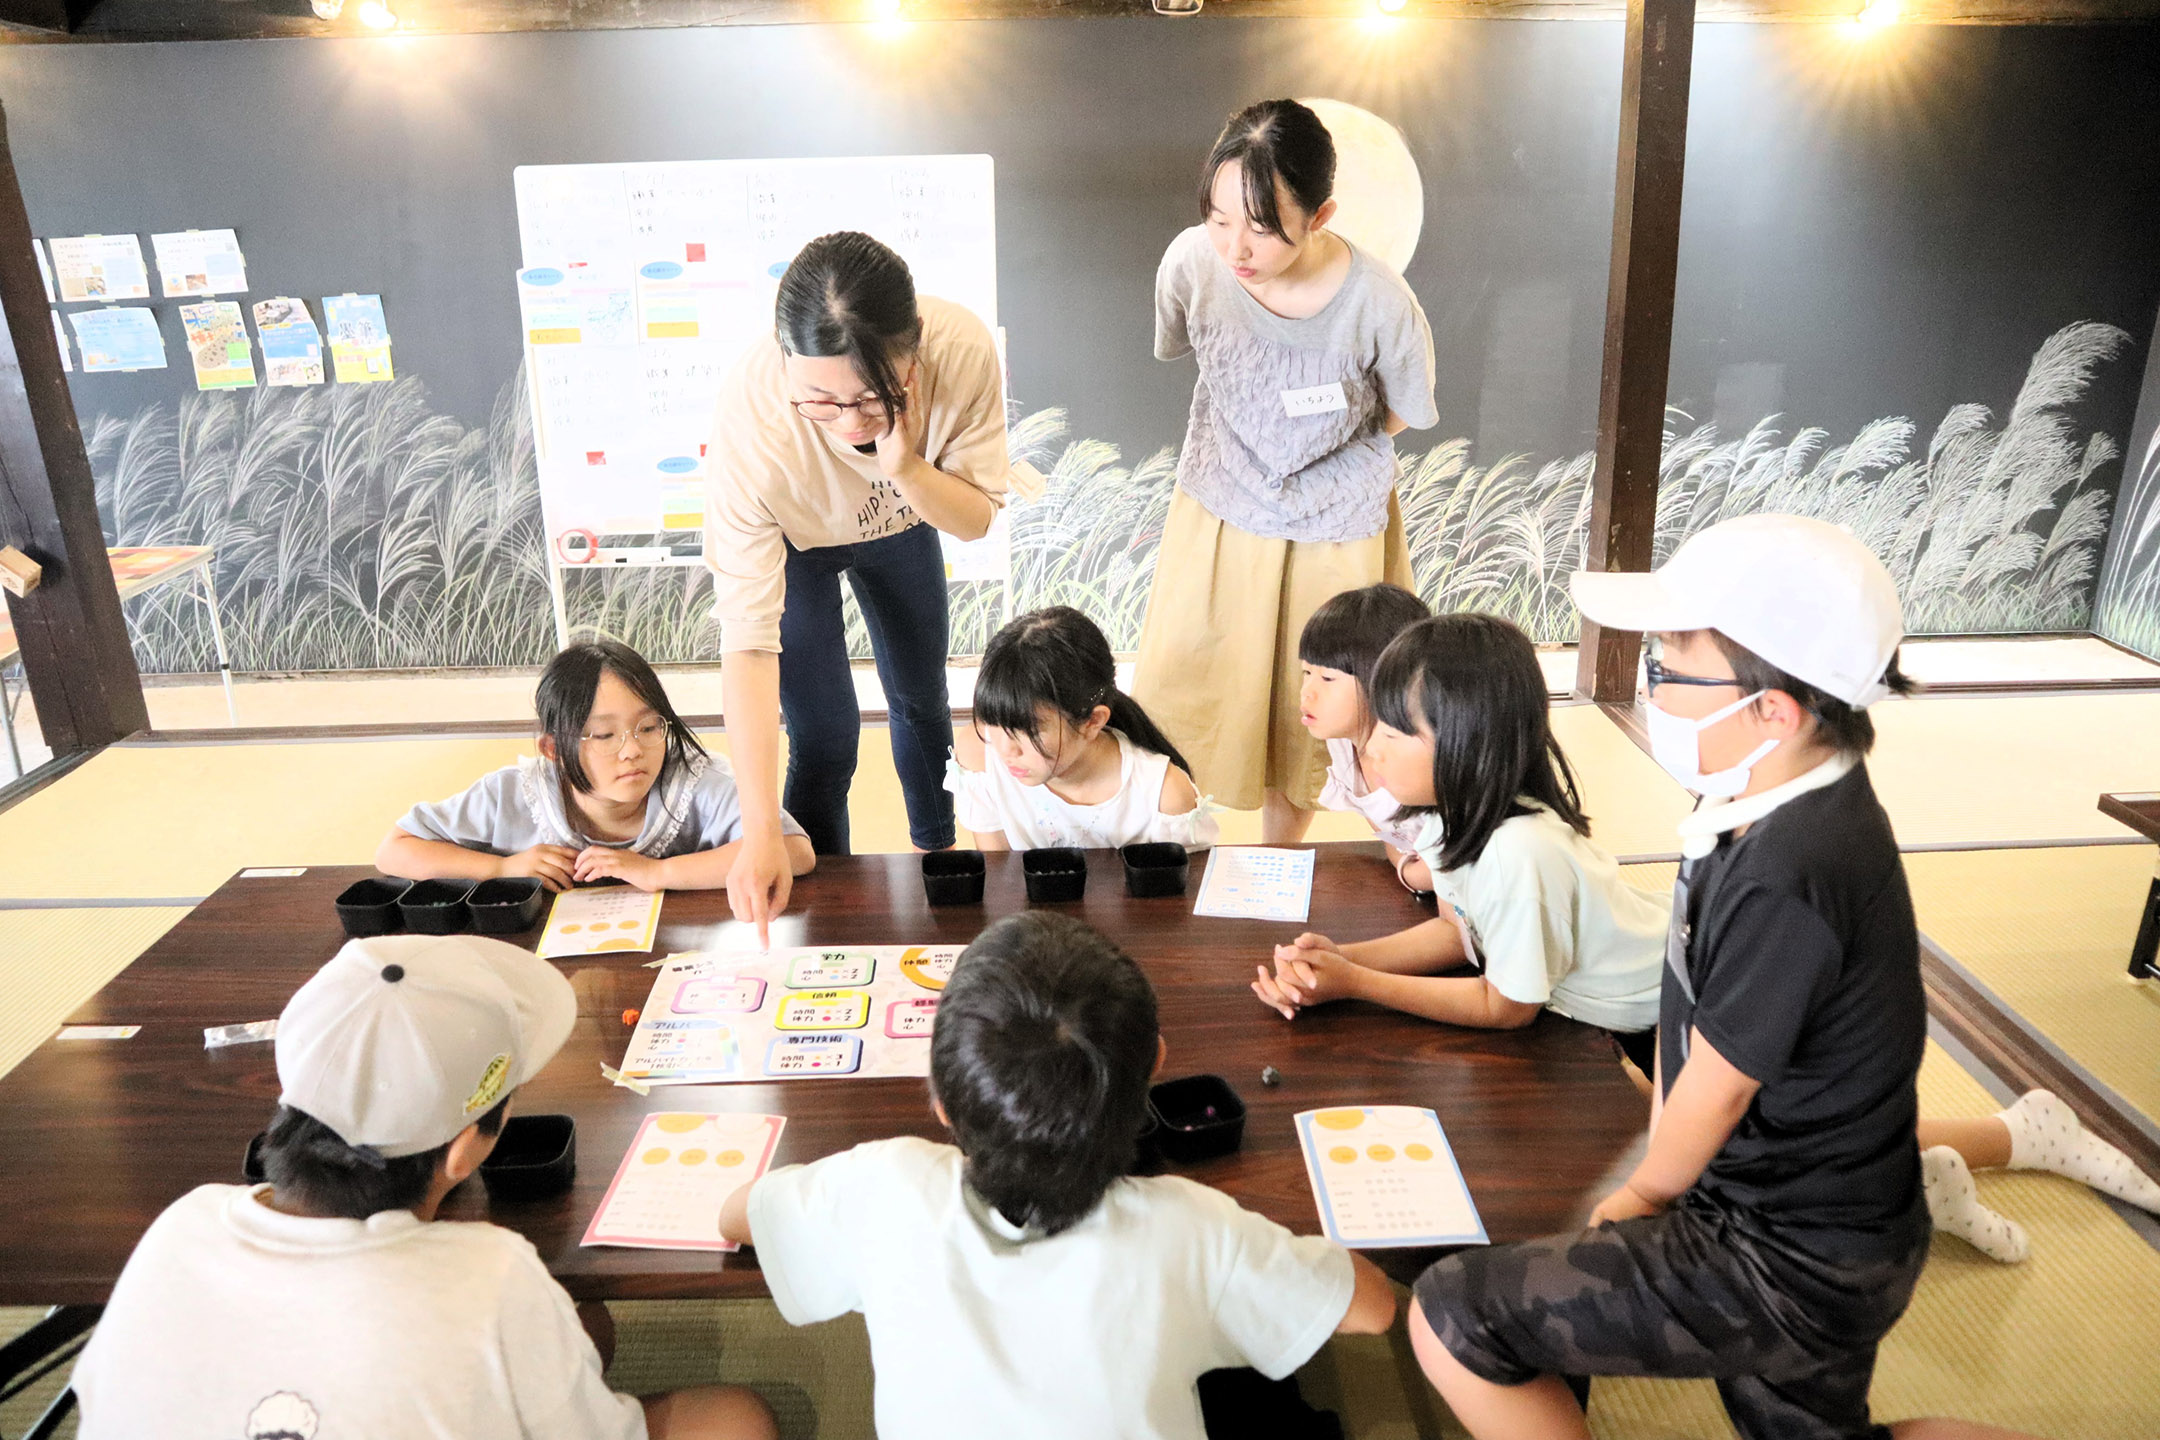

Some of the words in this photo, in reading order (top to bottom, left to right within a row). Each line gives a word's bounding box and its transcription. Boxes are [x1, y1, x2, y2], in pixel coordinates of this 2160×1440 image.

[857, 490, 889, 528] HIP!
[859, 516, 897, 540] THE
[821, 953, 846, 961] 学力
[787, 1035, 844, 1045] 専門技術
